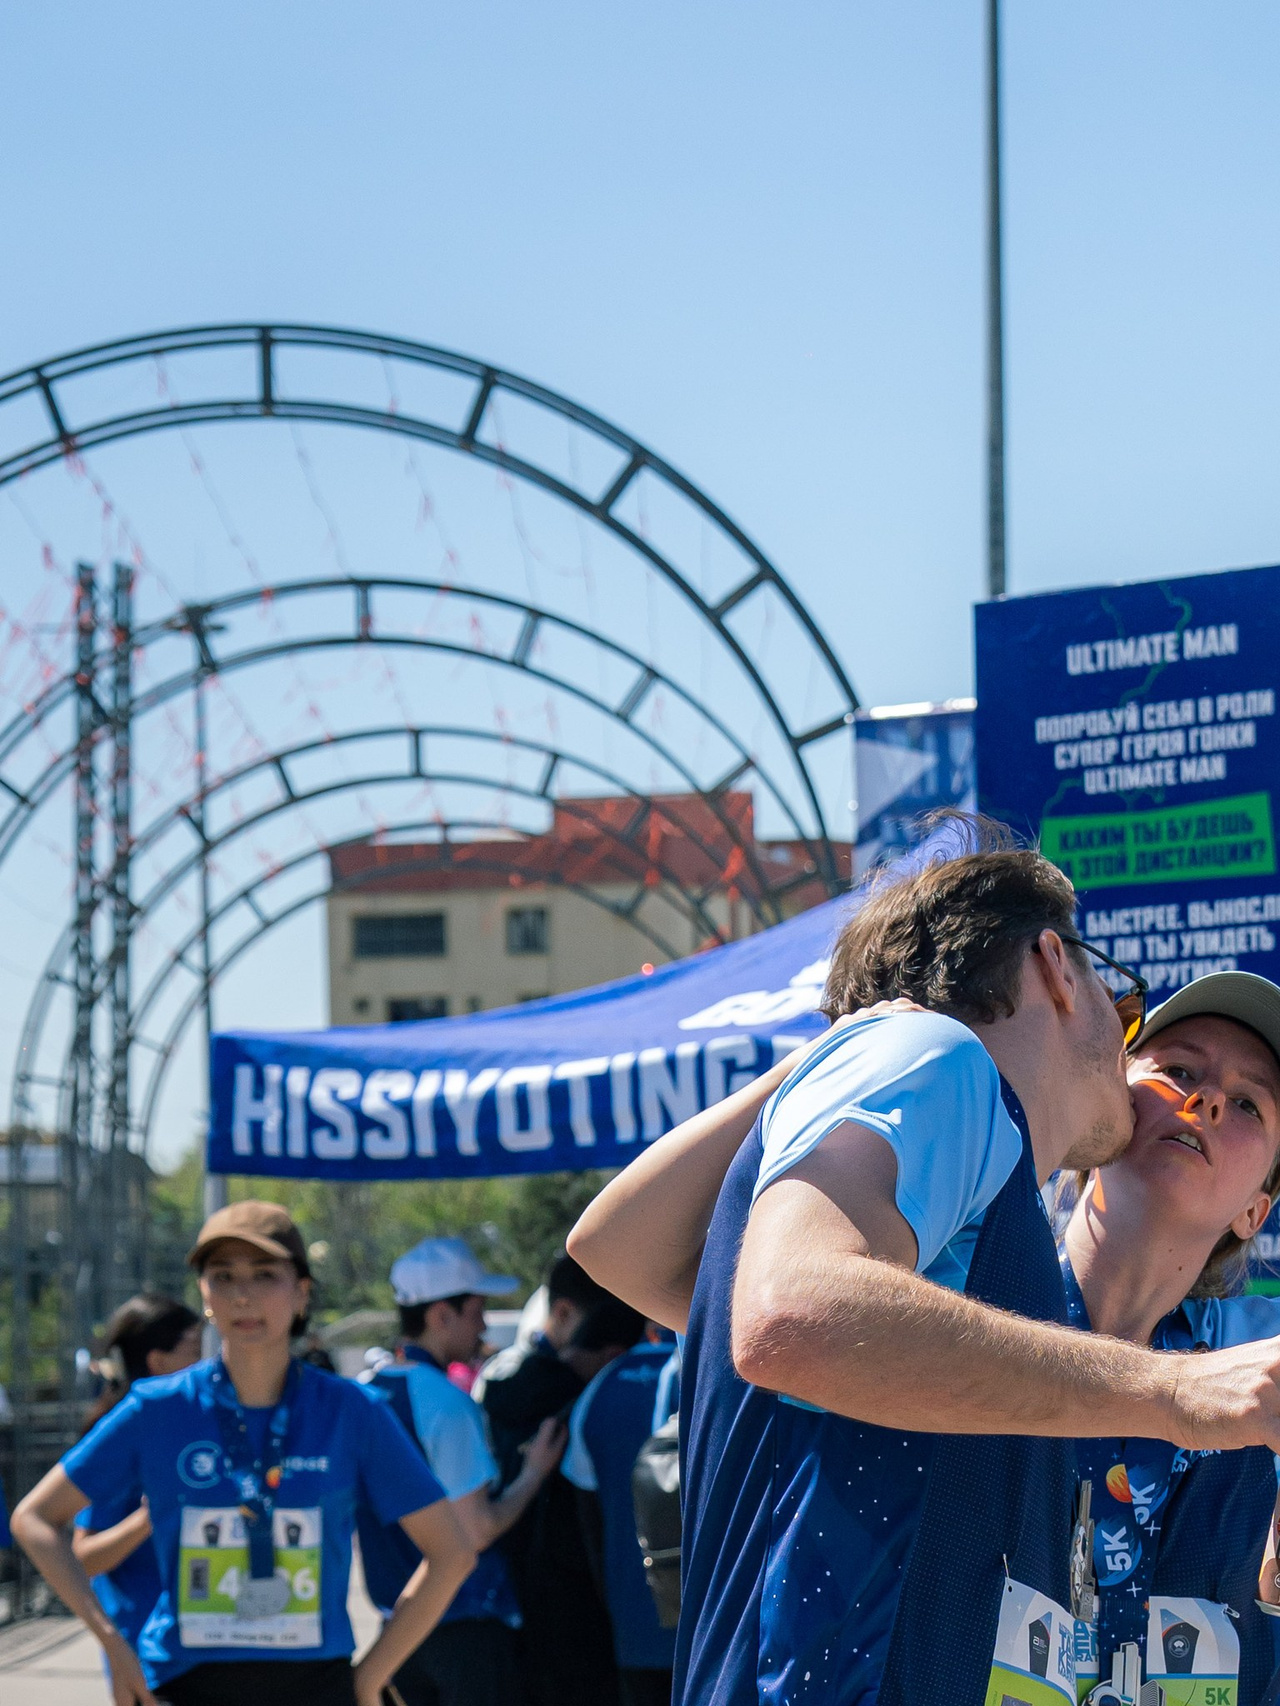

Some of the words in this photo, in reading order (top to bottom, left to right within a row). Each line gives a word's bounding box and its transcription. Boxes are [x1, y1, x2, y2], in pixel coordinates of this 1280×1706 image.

[1066, 631, 1180, 676] ULTIMATE
[1183, 623, 1239, 660] MAN
[1035, 701, 1140, 744] ПОПРОБУЙ
[1142, 699, 1196, 730] СЕБЯ
[1198, 695, 1214, 723] В
[1216, 688, 1276, 722] РОЛИ
[1054, 736, 1119, 770] СУПЕР
[1122, 729, 1186, 762] ГЕРОЯ
[1189, 720, 1257, 753] ГОНКИ
[1083, 758, 1178, 796] ULTIMATE
[1180, 753, 1227, 787] MAN
[1058, 825, 1127, 851] КАКИМ
[1131, 820, 1161, 845] ТЫ
[1166, 811, 1255, 842] БУДЕШЬ
[1078, 852, 1128, 880] ЭТОЙ
[1136, 839, 1267, 876] ДИСТАНЦИИ?
[1085, 902, 1185, 938] БЫСТРЕЕ.
[1144, 933, 1177, 960] ТЫ
[1180, 925, 1275, 957] УВИДЕТЬ
[231, 1033, 813, 1161] HISSIYOTING
[1101, 1525, 1133, 1572] 5K
[1204, 1686, 1232, 1706] 5K
